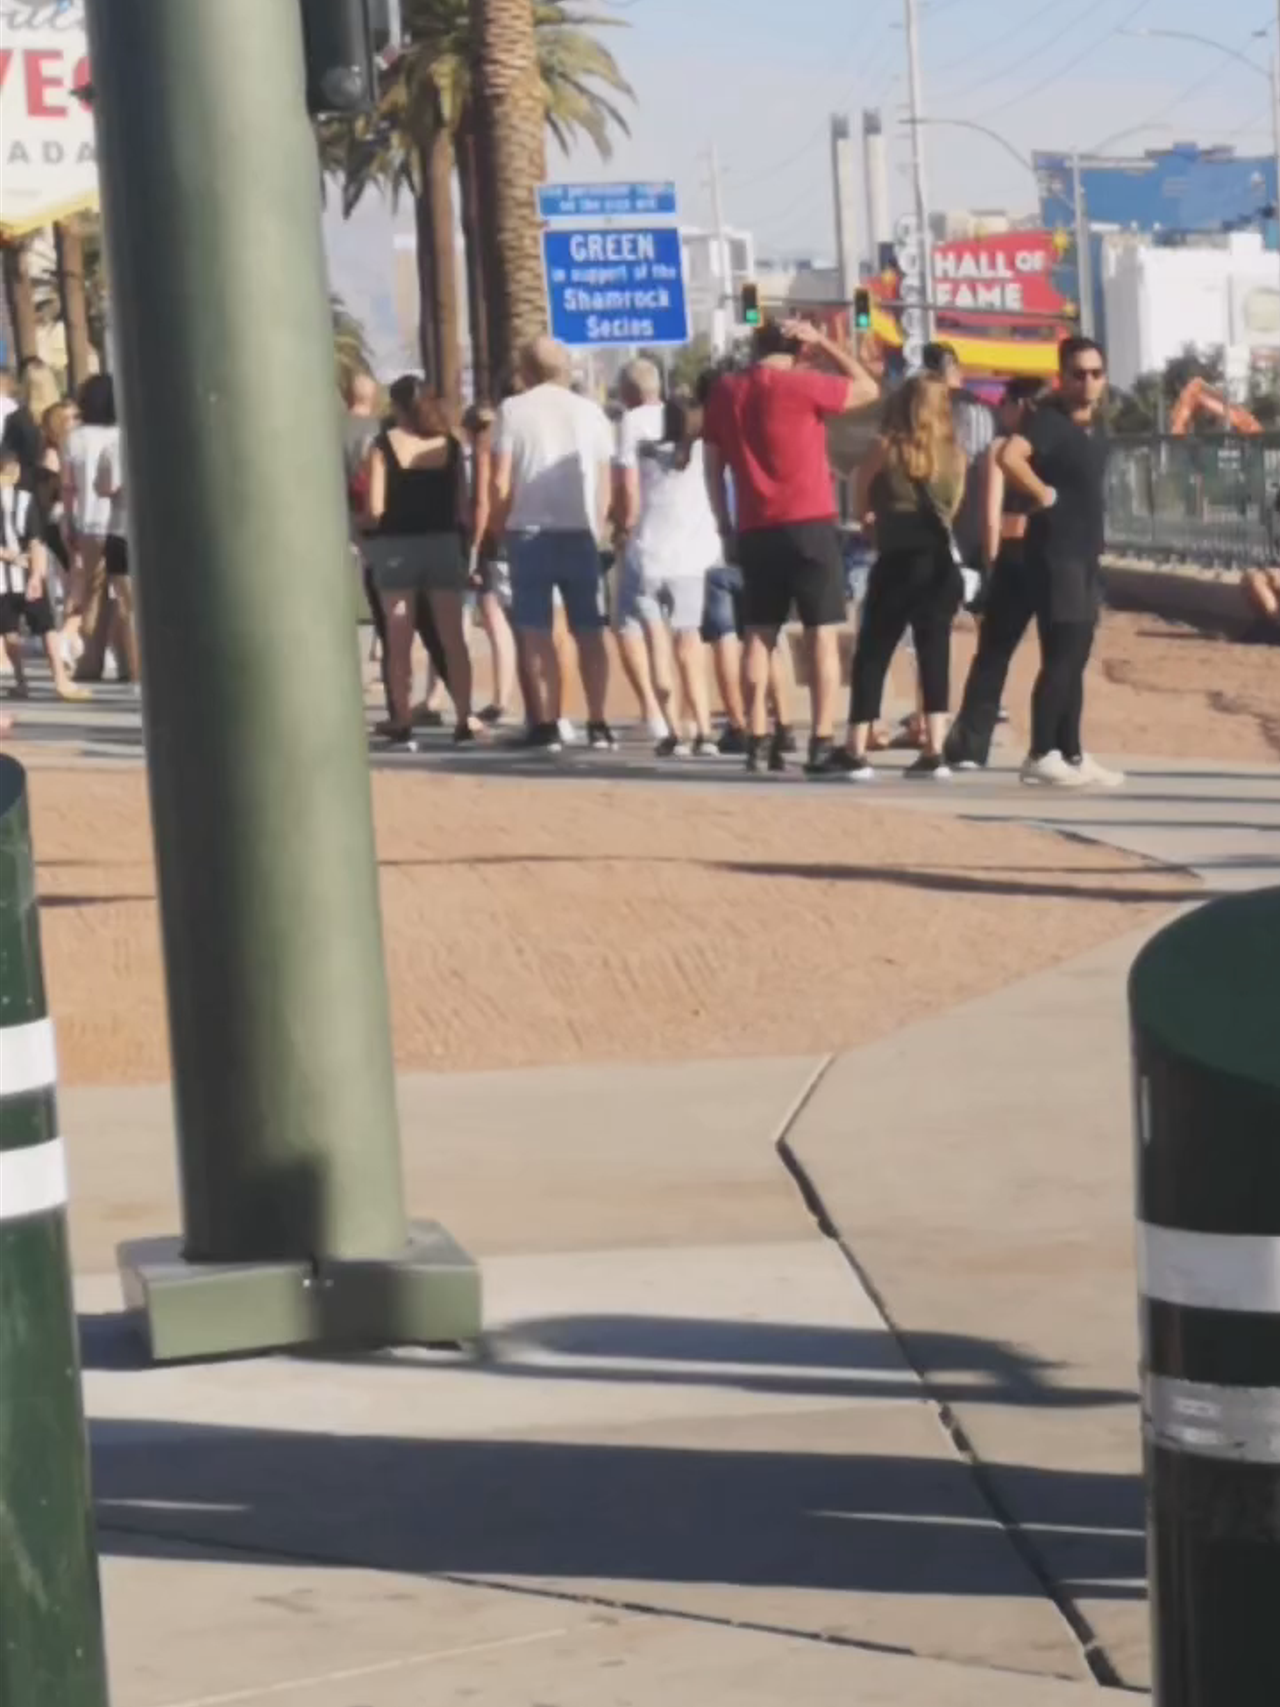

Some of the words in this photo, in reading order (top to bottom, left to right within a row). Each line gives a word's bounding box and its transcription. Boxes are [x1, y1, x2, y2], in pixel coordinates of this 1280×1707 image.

[569, 234, 655, 262] GREEN
[933, 250, 1013, 279] HALL
[1014, 250, 1047, 271] OF
[564, 287, 670, 311] Shamrock
[935, 281, 1023, 311] FAME
